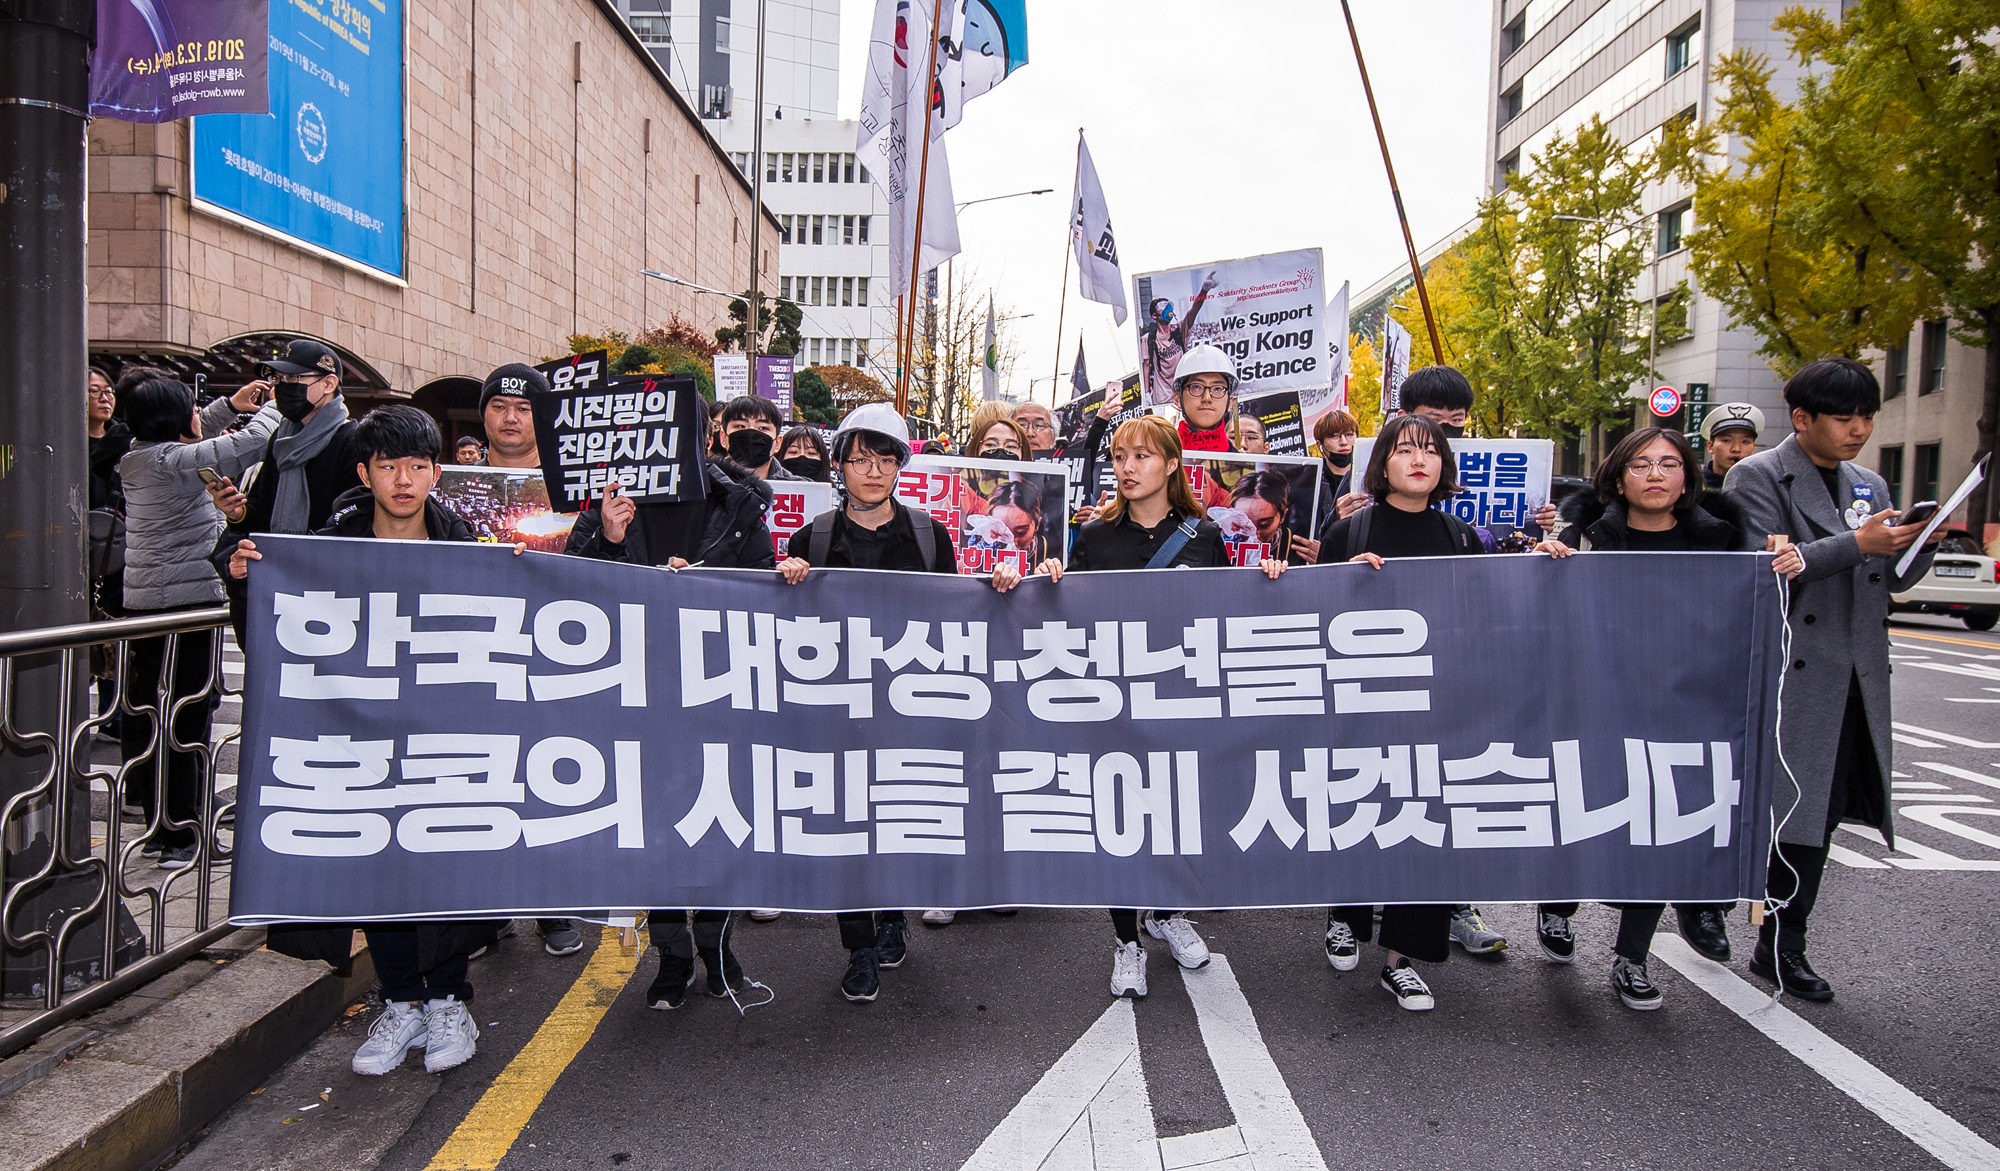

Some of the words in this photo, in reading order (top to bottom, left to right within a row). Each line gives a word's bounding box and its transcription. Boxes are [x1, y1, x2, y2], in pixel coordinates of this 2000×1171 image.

[263, 168, 283, 188] 2019
[1217, 287, 1248, 299] Solidarity
[1249, 283, 1278, 293] Students
[1278, 279, 1300, 287] Group
[1220, 317, 1246, 332] We
[1249, 303, 1313, 327] Support
[1256, 329, 1314, 353] Kong
[501, 377, 527, 391] BOY
[550, 360, 600, 392] 요구
[1236, 356, 1317, 382] istance
[554, 390, 676, 430] 시진핑의
[1269, 421, 1300, 436] Administration!
[1269, 436, 1293, 451] ckdown
[1293, 434, 1303, 445] on
[1691, 405, 1703, 449] Cantna
[558, 427, 680, 466] 진압지시
[563, 463, 682, 501] 규탄한다
[1454, 452, 1528, 488] 법을
[899, 471, 966, 507] 국가
[762, 493, 805, 528] 쟁
[1226, 541, 1273, 567] 다
[273, 590, 647, 708] 한국의
[678, 607, 1433, 721] 대학생·청년들은
[259, 733, 646, 857] 홍콩의
[673, 742, 970, 857] 시민들
[992, 750, 1203, 858] 곁에
[1228, 737, 1741, 852] 서겠습니다
